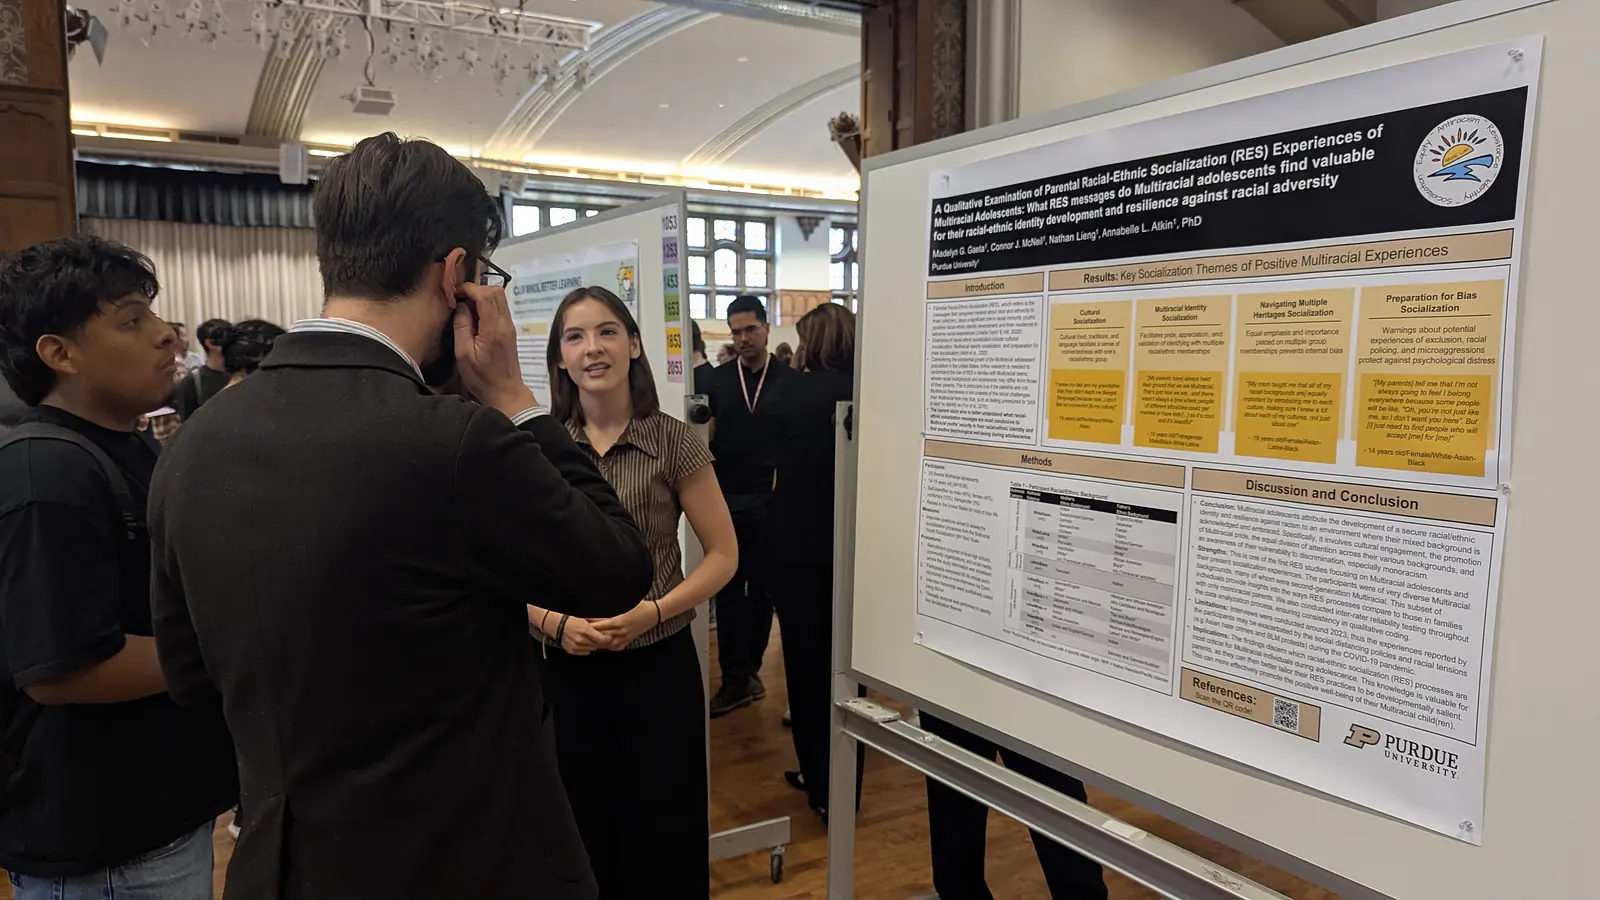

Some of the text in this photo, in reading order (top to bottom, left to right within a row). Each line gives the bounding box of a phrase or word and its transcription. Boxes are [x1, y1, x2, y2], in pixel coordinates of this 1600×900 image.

[1416, 139, 1433, 165] Equity
[934, 123, 1383, 214] A Qualitative Examination of Parental Racial-Ethnic Socialization (RES) Experiences of
[934, 147, 1374, 227] Multiracial Adolescents: What RES messages do Multiracial adolescents find valuable
[933, 173, 1339, 240] for their racial-ethnic identity development and resilience against racial adversity
[662, 215, 678, 231] 1053
[932, 248, 958, 258] Madelyn
[959, 246, 965, 255] G.
[990, 242, 1014, 251] Connor
[1014, 239, 1020, 248] J.
[1048, 233, 1074, 244] Nathan
[1101, 224, 1139, 237] Annabelle
[1141, 223, 1149, 232] L.
[1181, 215, 1202, 227] PhD
[663, 243, 678, 259] 1253
[1083, 246, 1448, 283] Results: Key Socialization Themes of Positive Multiracial Experiences
[663, 273, 679, 290] 1453
[964, 281, 1004, 292] Introduction
[1259, 298, 1327, 309] Navigating Multiple
[1386, 291, 1477, 304] Preparation for Bias
[1184, 304, 1207, 312] Identity
[1287, 309, 1334, 317] Socialization
[1400, 304, 1459, 313] Socialization
[1382, 326, 1416, 335] Warnings
[1442, 325, 1476, 334] potential
[666, 333, 682, 349] 1853
[1370, 336, 1414, 345] experiences
[1425, 335, 1464, 344] exclusion,
[1466, 335, 1486, 343] racial
[1370, 346, 1398, 355] policing,
[1417, 346, 1485, 355] microaggressions
[667, 360, 683, 376] 2053
[1384, 356, 1411, 365] against
[1412, 356, 1465, 365] psychological
[1021, 454, 1052, 466] Methods
[1246, 479, 1418, 510] Discussion and Conclusion
[1191, 650, 1202, 659] This
[1214, 658, 1229, 666] more
[1230, 662, 1258, 675] effectively
[1259, 670, 1283, 681] promote
[1283, 676, 1293, 684] the
[1294, 680, 1319, 691] positive
[1320, 687, 1353, 703] well-being
[1363, 698, 1378, 708] their
[1379, 702, 1416, 719] Multiracial
[1192, 676, 1256, 705] References:
[1195, 691, 1252, 714] Scan the QR code!
[1385, 733, 1459, 769] PURDUE
[1384, 749, 1457, 779] UNIVERSITY
